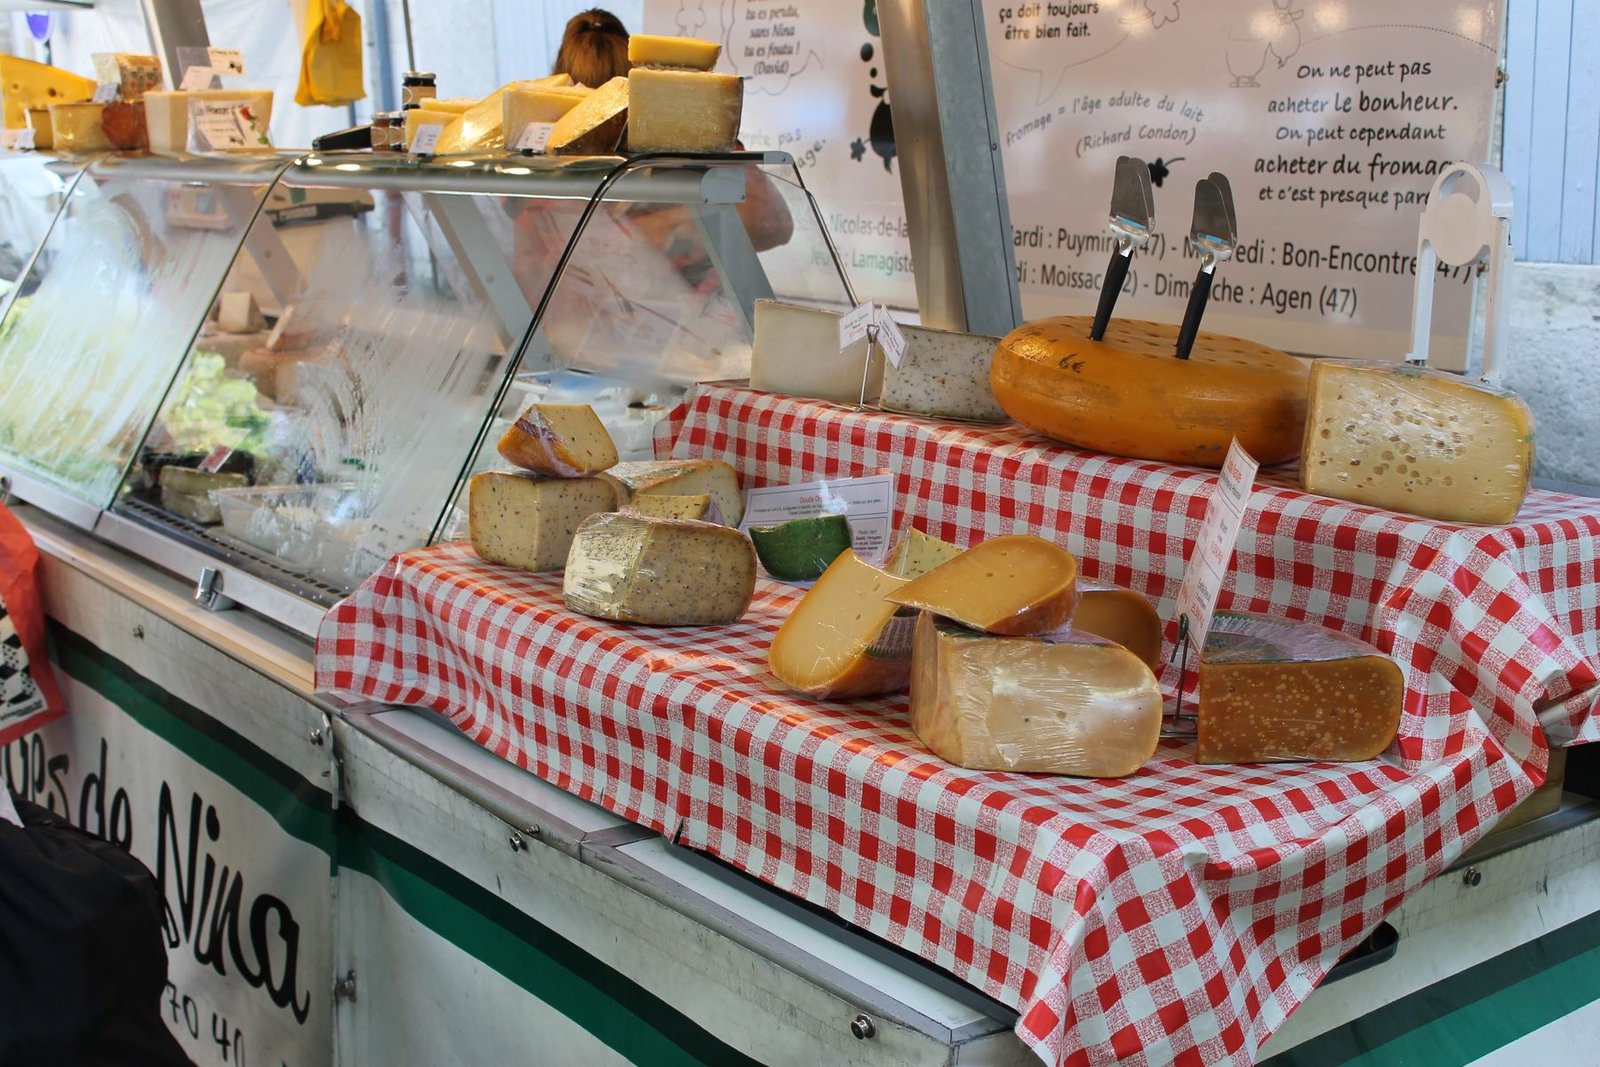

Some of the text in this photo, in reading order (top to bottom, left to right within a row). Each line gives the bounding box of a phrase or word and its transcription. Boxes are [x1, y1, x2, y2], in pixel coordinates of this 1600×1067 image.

[999, 1, 1099, 23] ça doit toujours
[772, 24, 796, 37] Nina
[1005, 22, 1091, 40] être bien fait.
[753, 60, 789, 76] (David)
[1297, 61, 1432, 84] On ne peut pas
[1267, 91, 1458, 113] acheter le bonheur.
[1006, 113, 1052, 147] fromage
[1073, 95, 1101, 114] l'âge
[1108, 90, 1150, 108] adulte
[1157, 94, 1174, 112] du
[1180, 101, 1204, 122] lait
[1076, 123, 1196, 158] (Richard Condon)
[1275, 122, 1447, 146] On peut cependant
[1254, 152, 1452, 182] acheter du froma
[1259, 185, 1430, 211] et c'est presque par
[1011, 225, 1043, 248] ardi
[1057, 228, 1119, 258] Puymir
[1282, 241, 1417, 276] Bon-Encontre
[1041, 264, 1102, 290] Moissac
[1155, 273, 1244, 304] Dimche
[1260, 282, 1312, 314] Agen
[1319, 285, 1357, 317] (47)
[157, 780, 310, 1026] Nina
